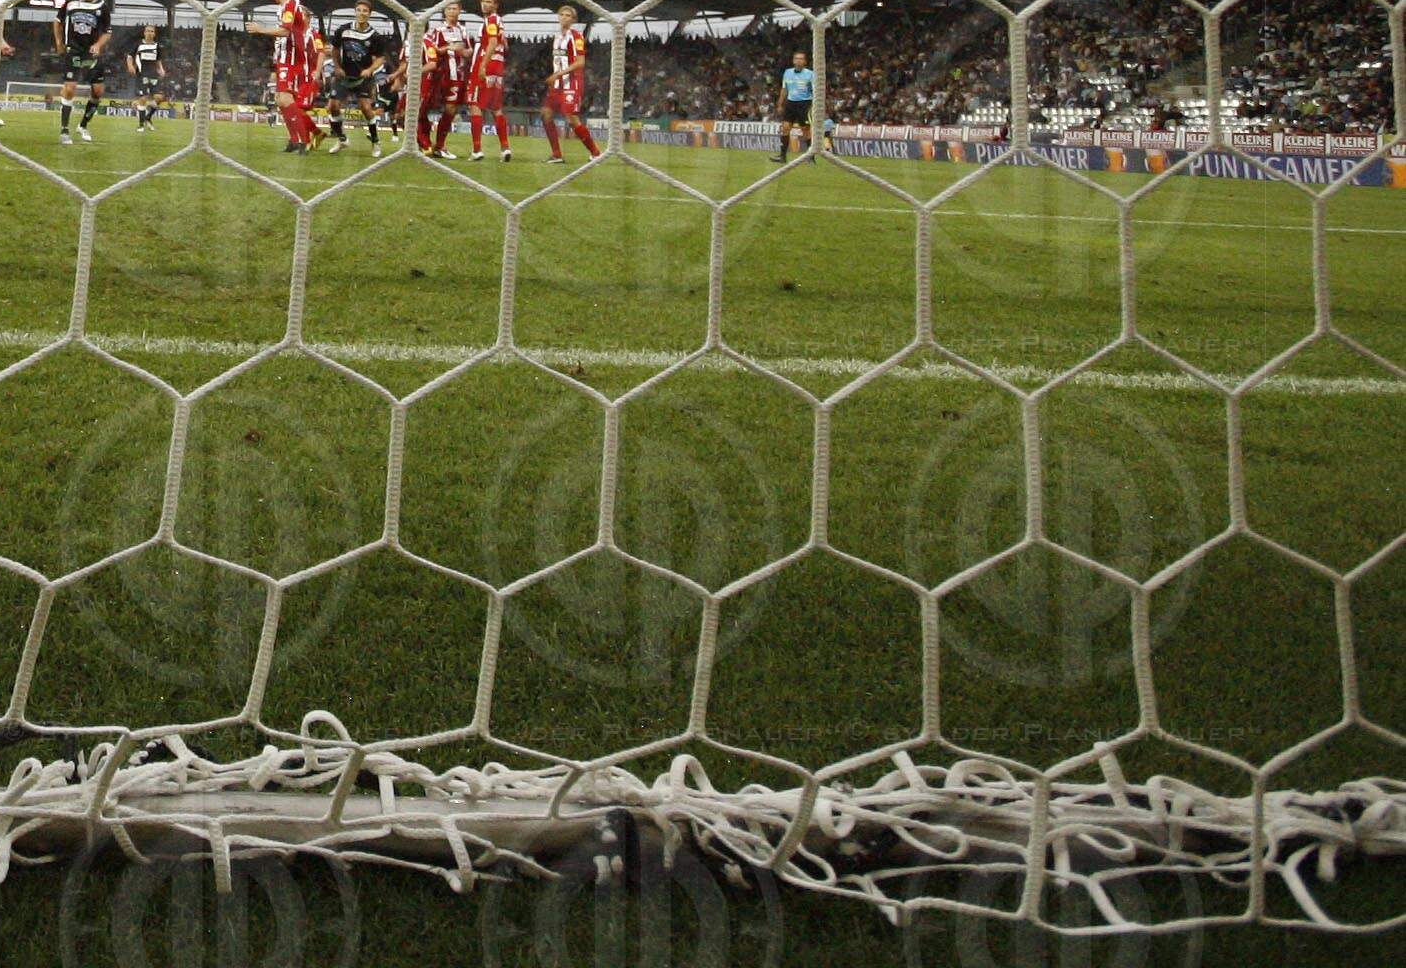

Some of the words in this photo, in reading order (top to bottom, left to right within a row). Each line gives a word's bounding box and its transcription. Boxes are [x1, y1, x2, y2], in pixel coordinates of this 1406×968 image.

[1142, 132, 1175, 142] KLEINE
[1234, 135, 1272, 146] KLEINE
[1284, 136, 1324, 147] KLEINE
[1331, 136, 1376, 148] KLEINE
[835, 139, 909, 160] UNTIGAMER
